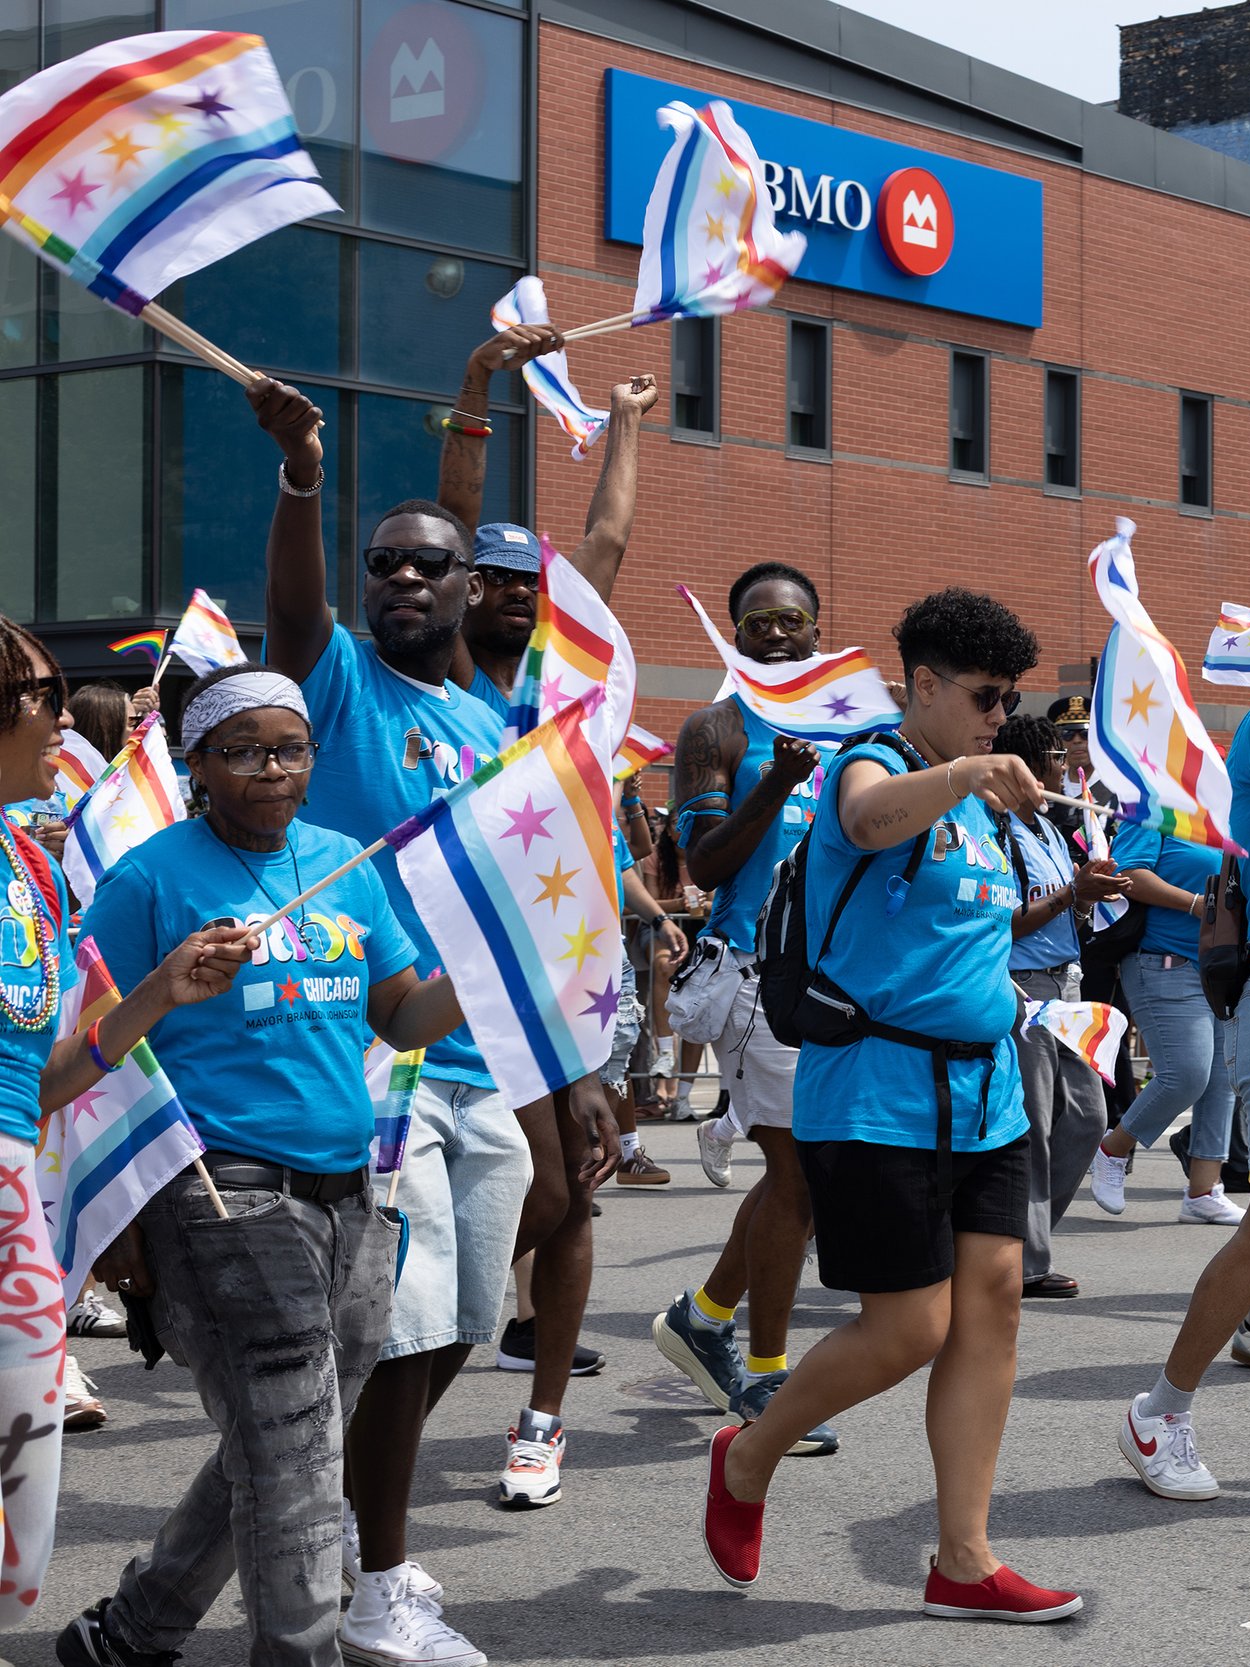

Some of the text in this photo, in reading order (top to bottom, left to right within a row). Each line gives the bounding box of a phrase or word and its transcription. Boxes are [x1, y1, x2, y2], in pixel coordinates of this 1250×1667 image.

[760, 159, 872, 231] BMO
[303, 975, 360, 1003] CHICAGO
[245, 1014, 284, 1029] MAYOR
